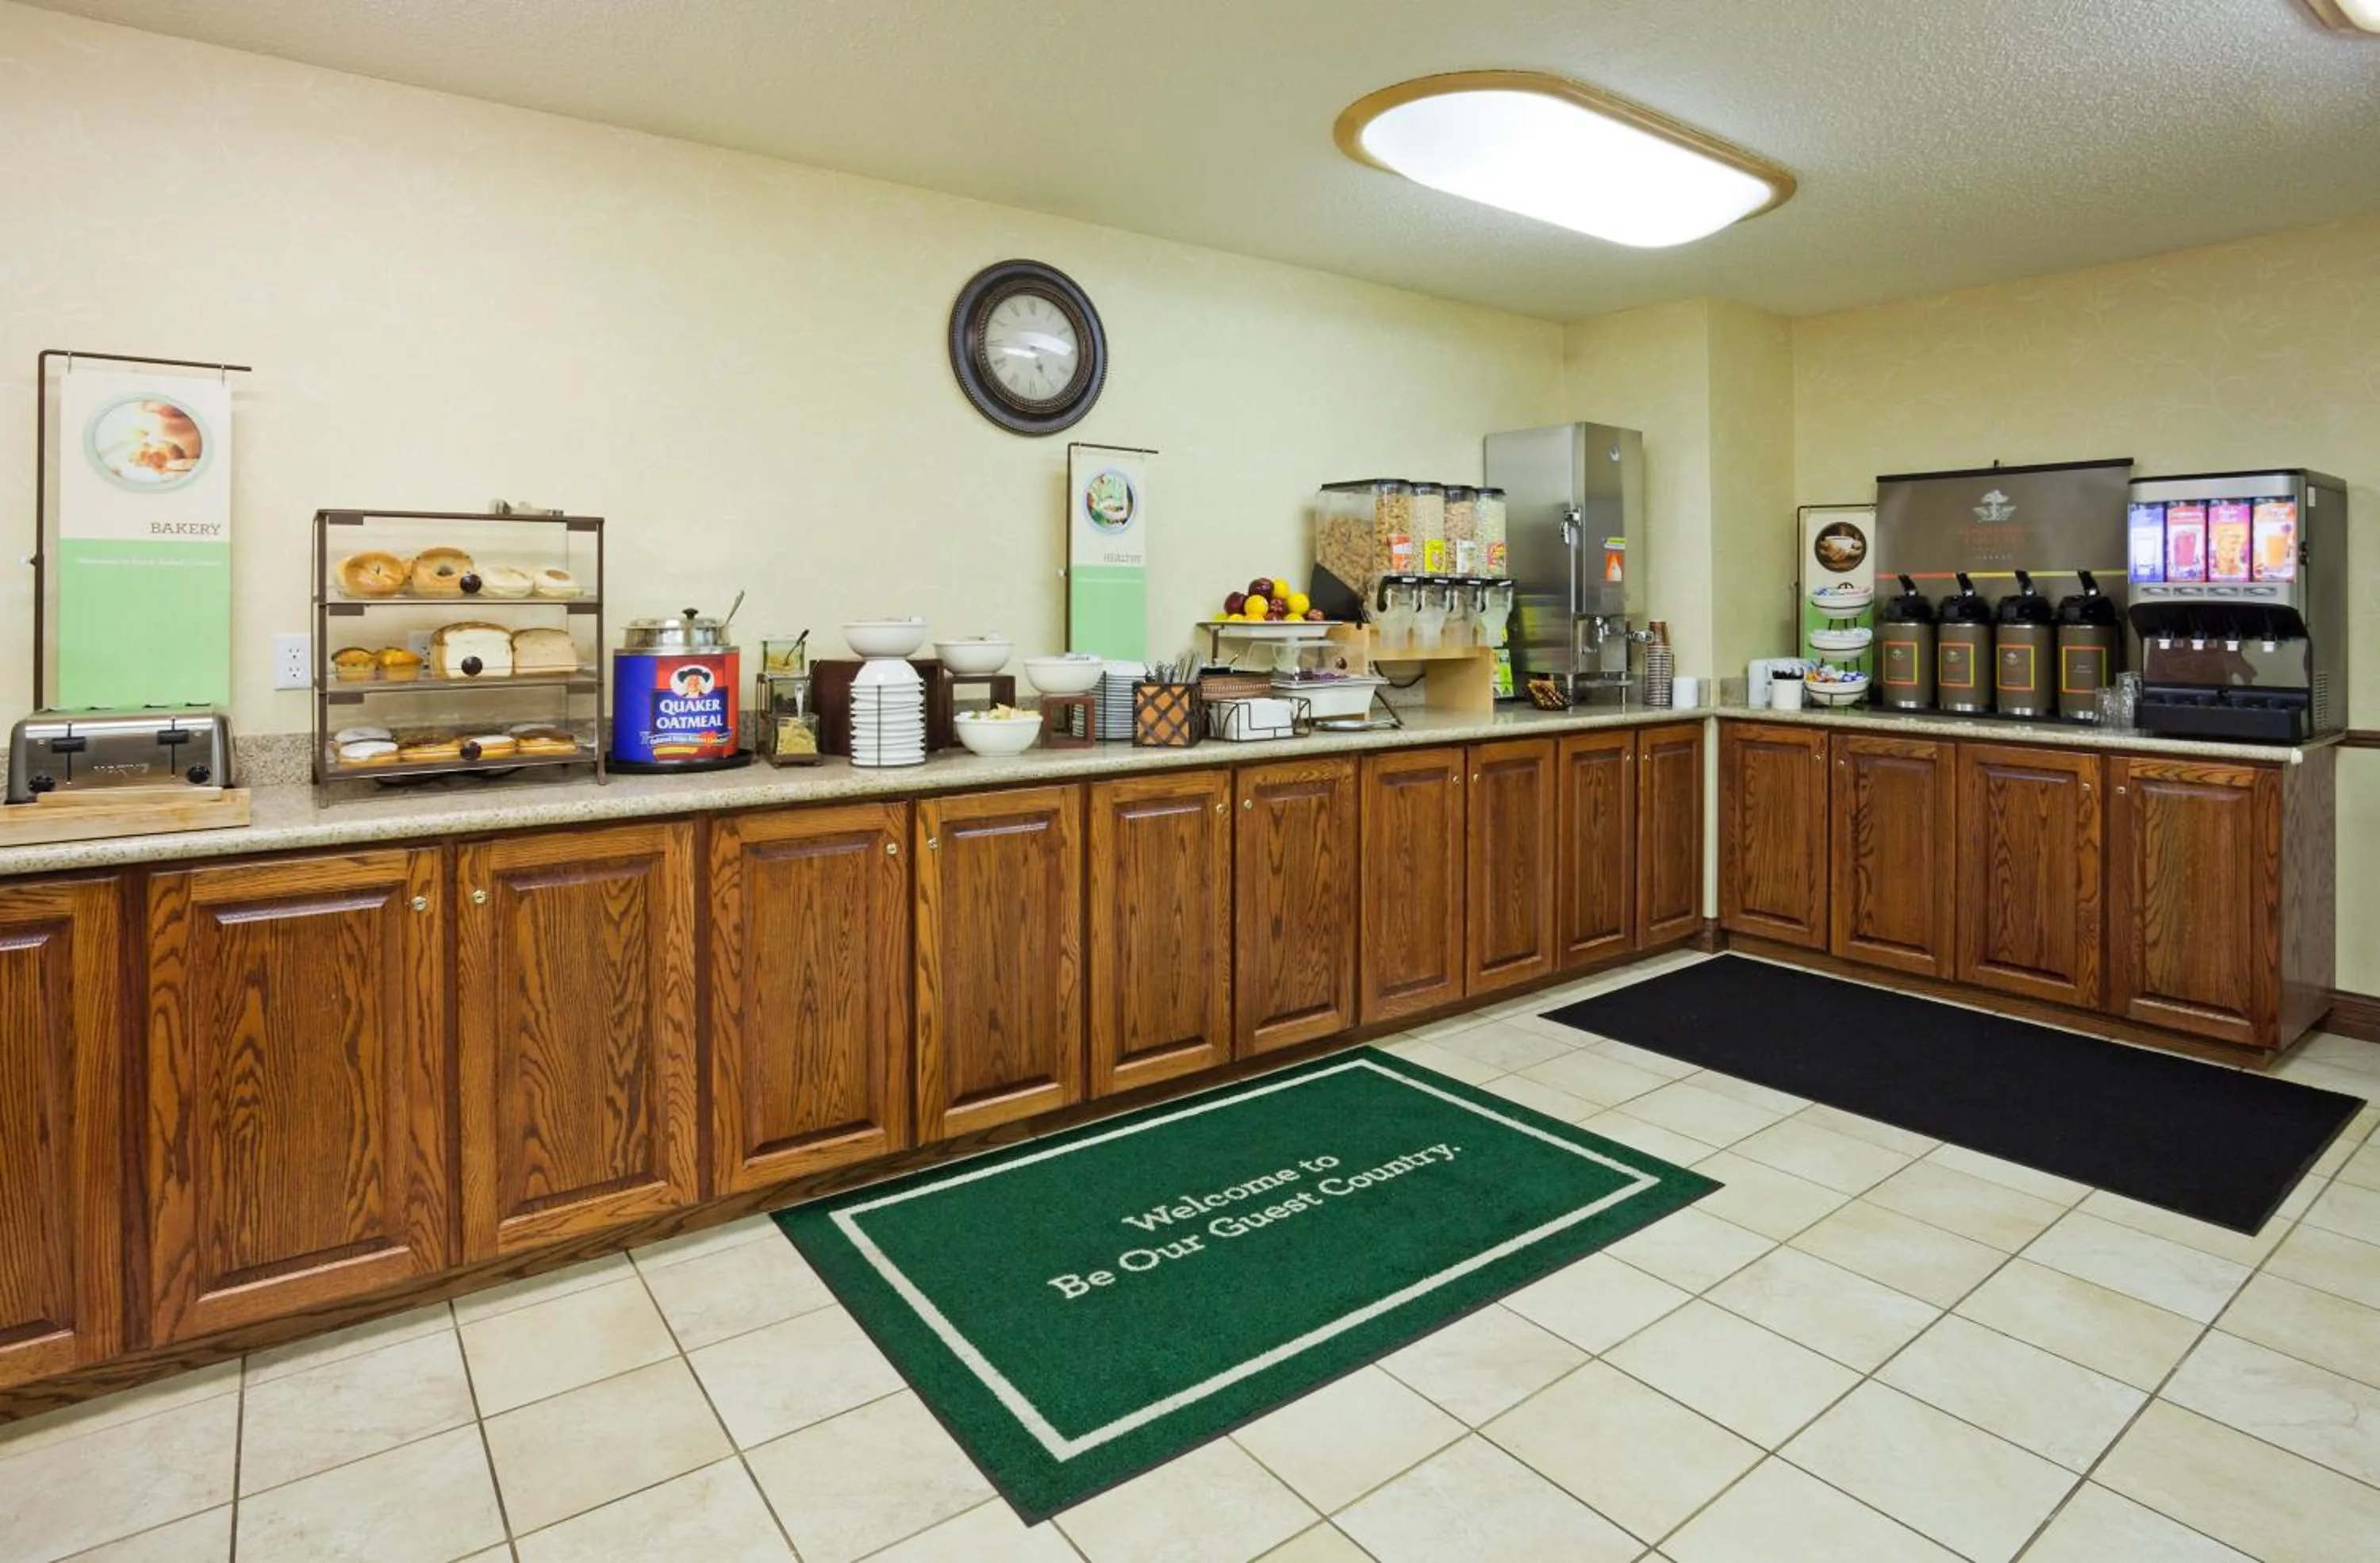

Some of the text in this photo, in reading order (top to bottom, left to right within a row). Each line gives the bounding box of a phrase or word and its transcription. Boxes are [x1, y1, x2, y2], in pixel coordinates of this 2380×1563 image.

[150, 522, 221, 536] BAKERY
[659, 699, 722, 716] QUAKER
[656, 715, 723, 729] OATMEAL
[1121, 1154, 1340, 1233] Welcome to
[1046, 1142, 1462, 1300] Be Our Guest Country.
